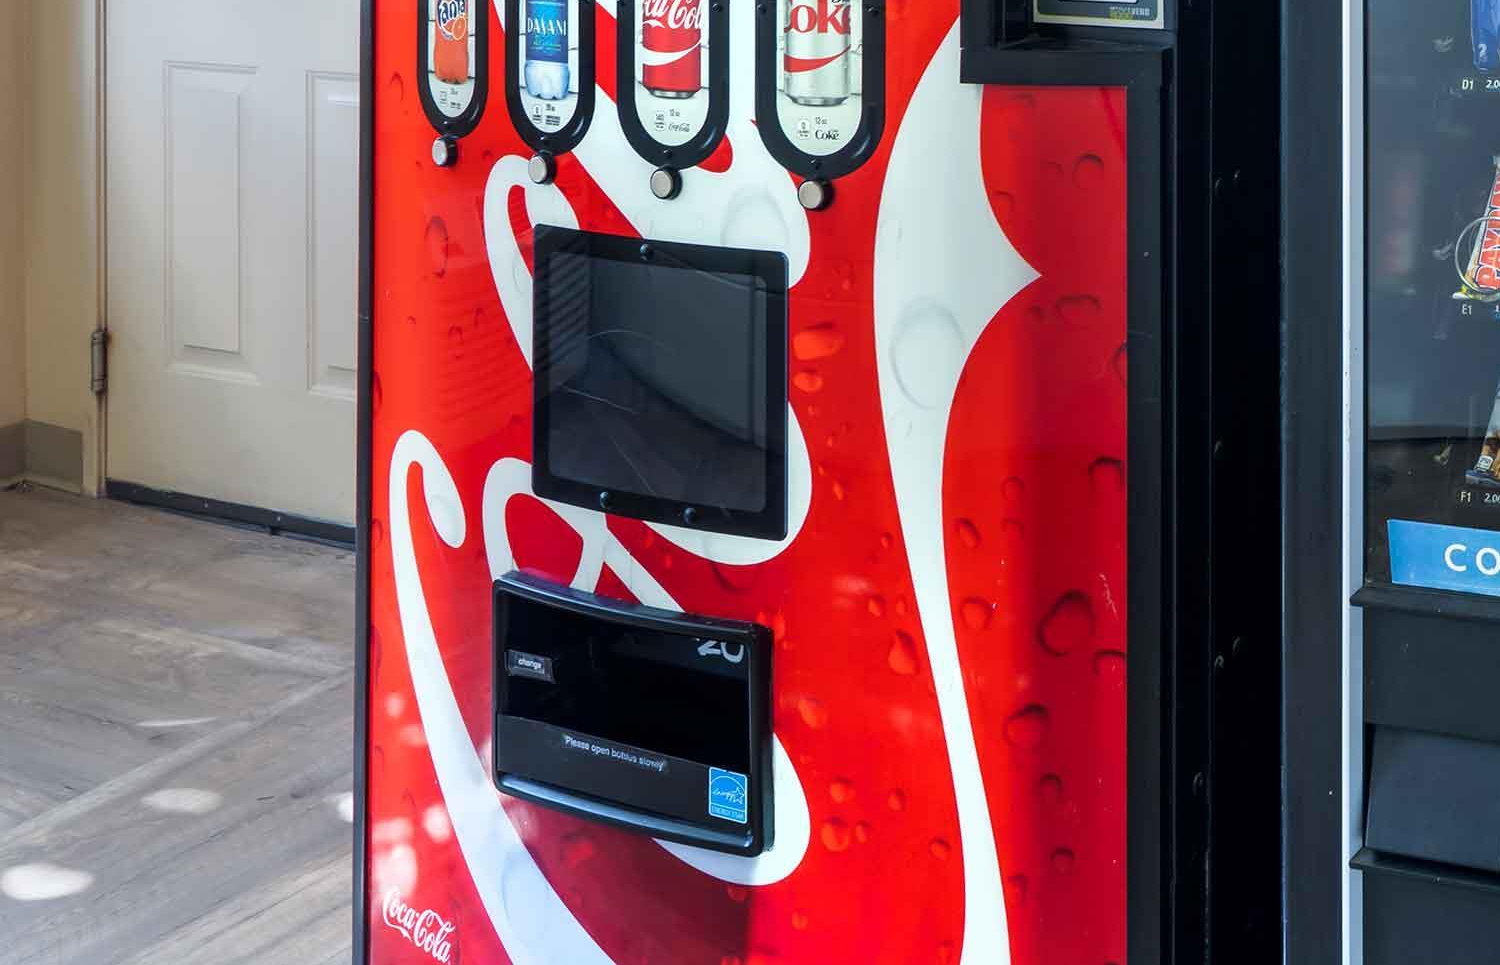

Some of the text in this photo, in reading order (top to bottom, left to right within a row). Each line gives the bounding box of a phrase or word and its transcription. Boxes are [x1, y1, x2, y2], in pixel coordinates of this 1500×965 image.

[527, 17, 568, 36] DASANI
[518, 657, 542, 670] change
[564, 736, 610, 756] Please open
[383, 888, 455, 964] Coca-Cola
